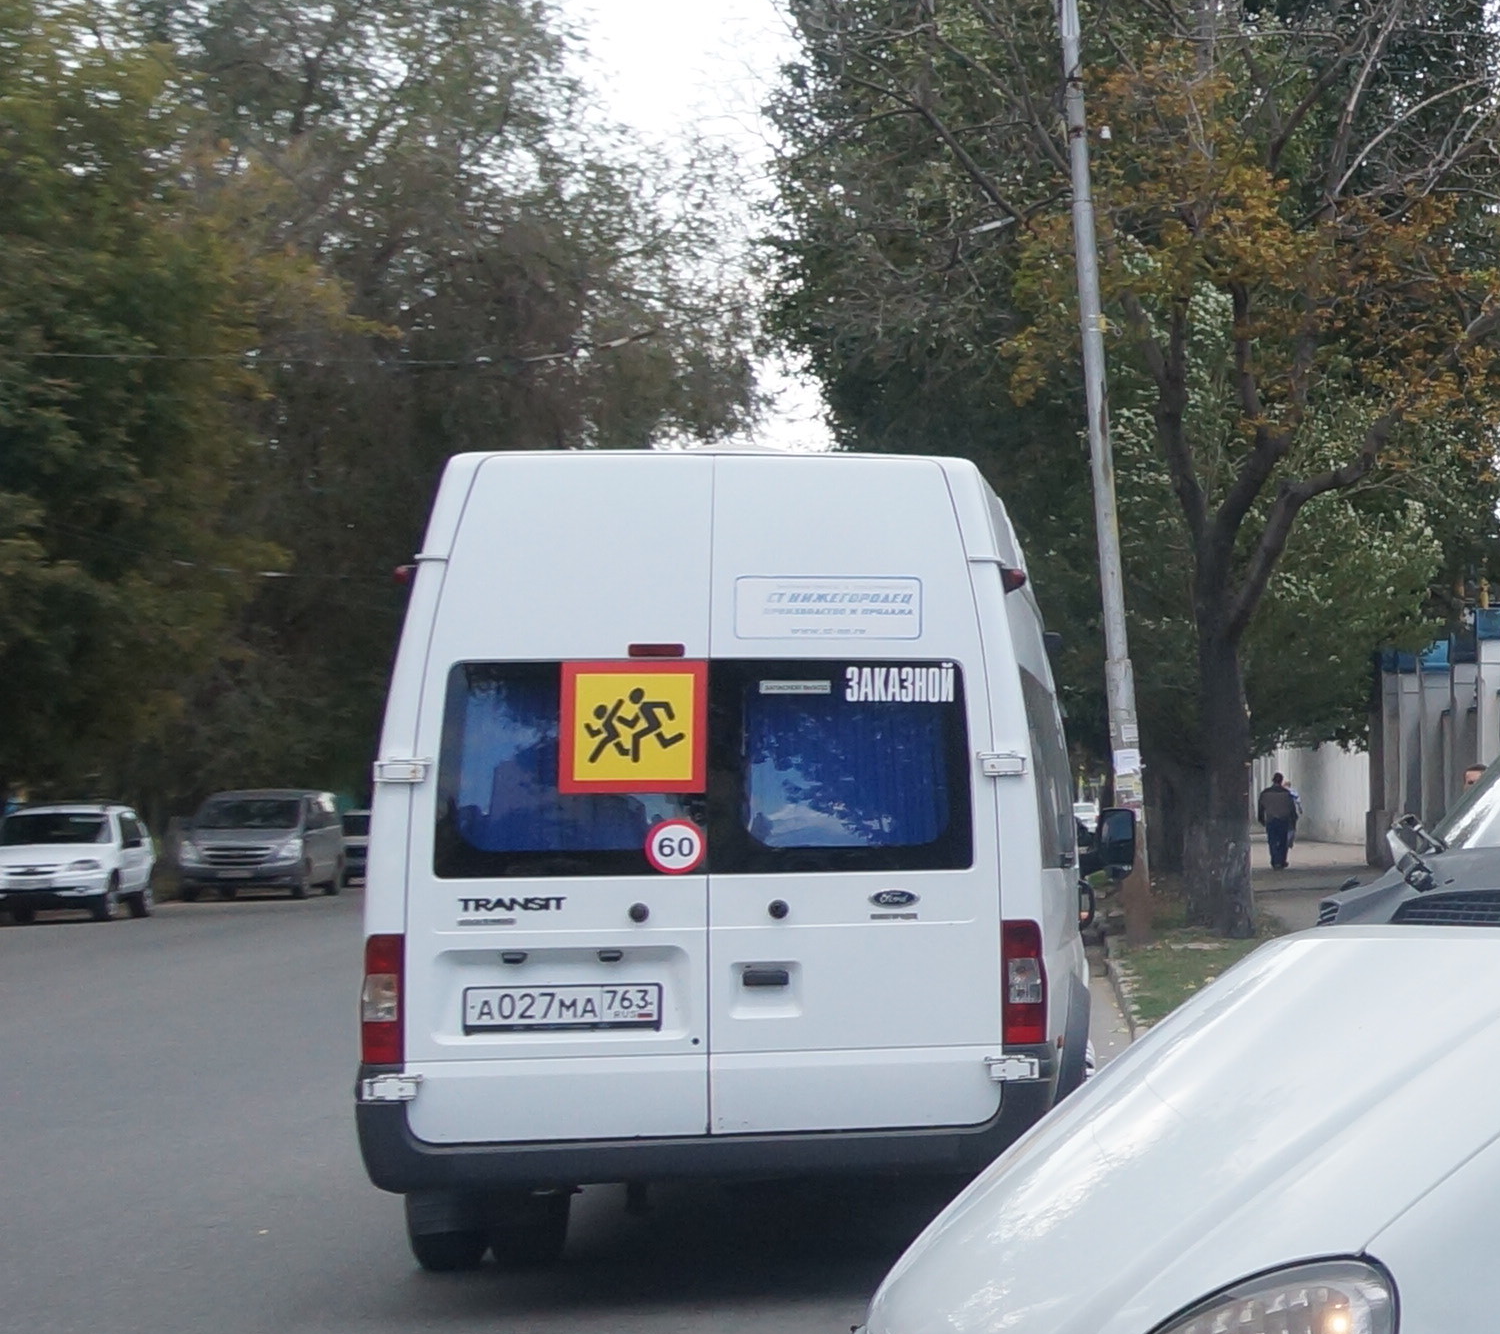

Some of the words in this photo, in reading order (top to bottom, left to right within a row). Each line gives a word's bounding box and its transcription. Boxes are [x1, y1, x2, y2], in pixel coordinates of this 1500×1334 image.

[845, 662, 954, 702] ЗАКАЗНОЙ
[658, 837, 694, 857] 60
[458, 896, 567, 912] TRANSIT
[880, 893, 908, 903] Ford
[604, 989, 649, 1011] 763
[614, 1010, 636, 1019] RUS
